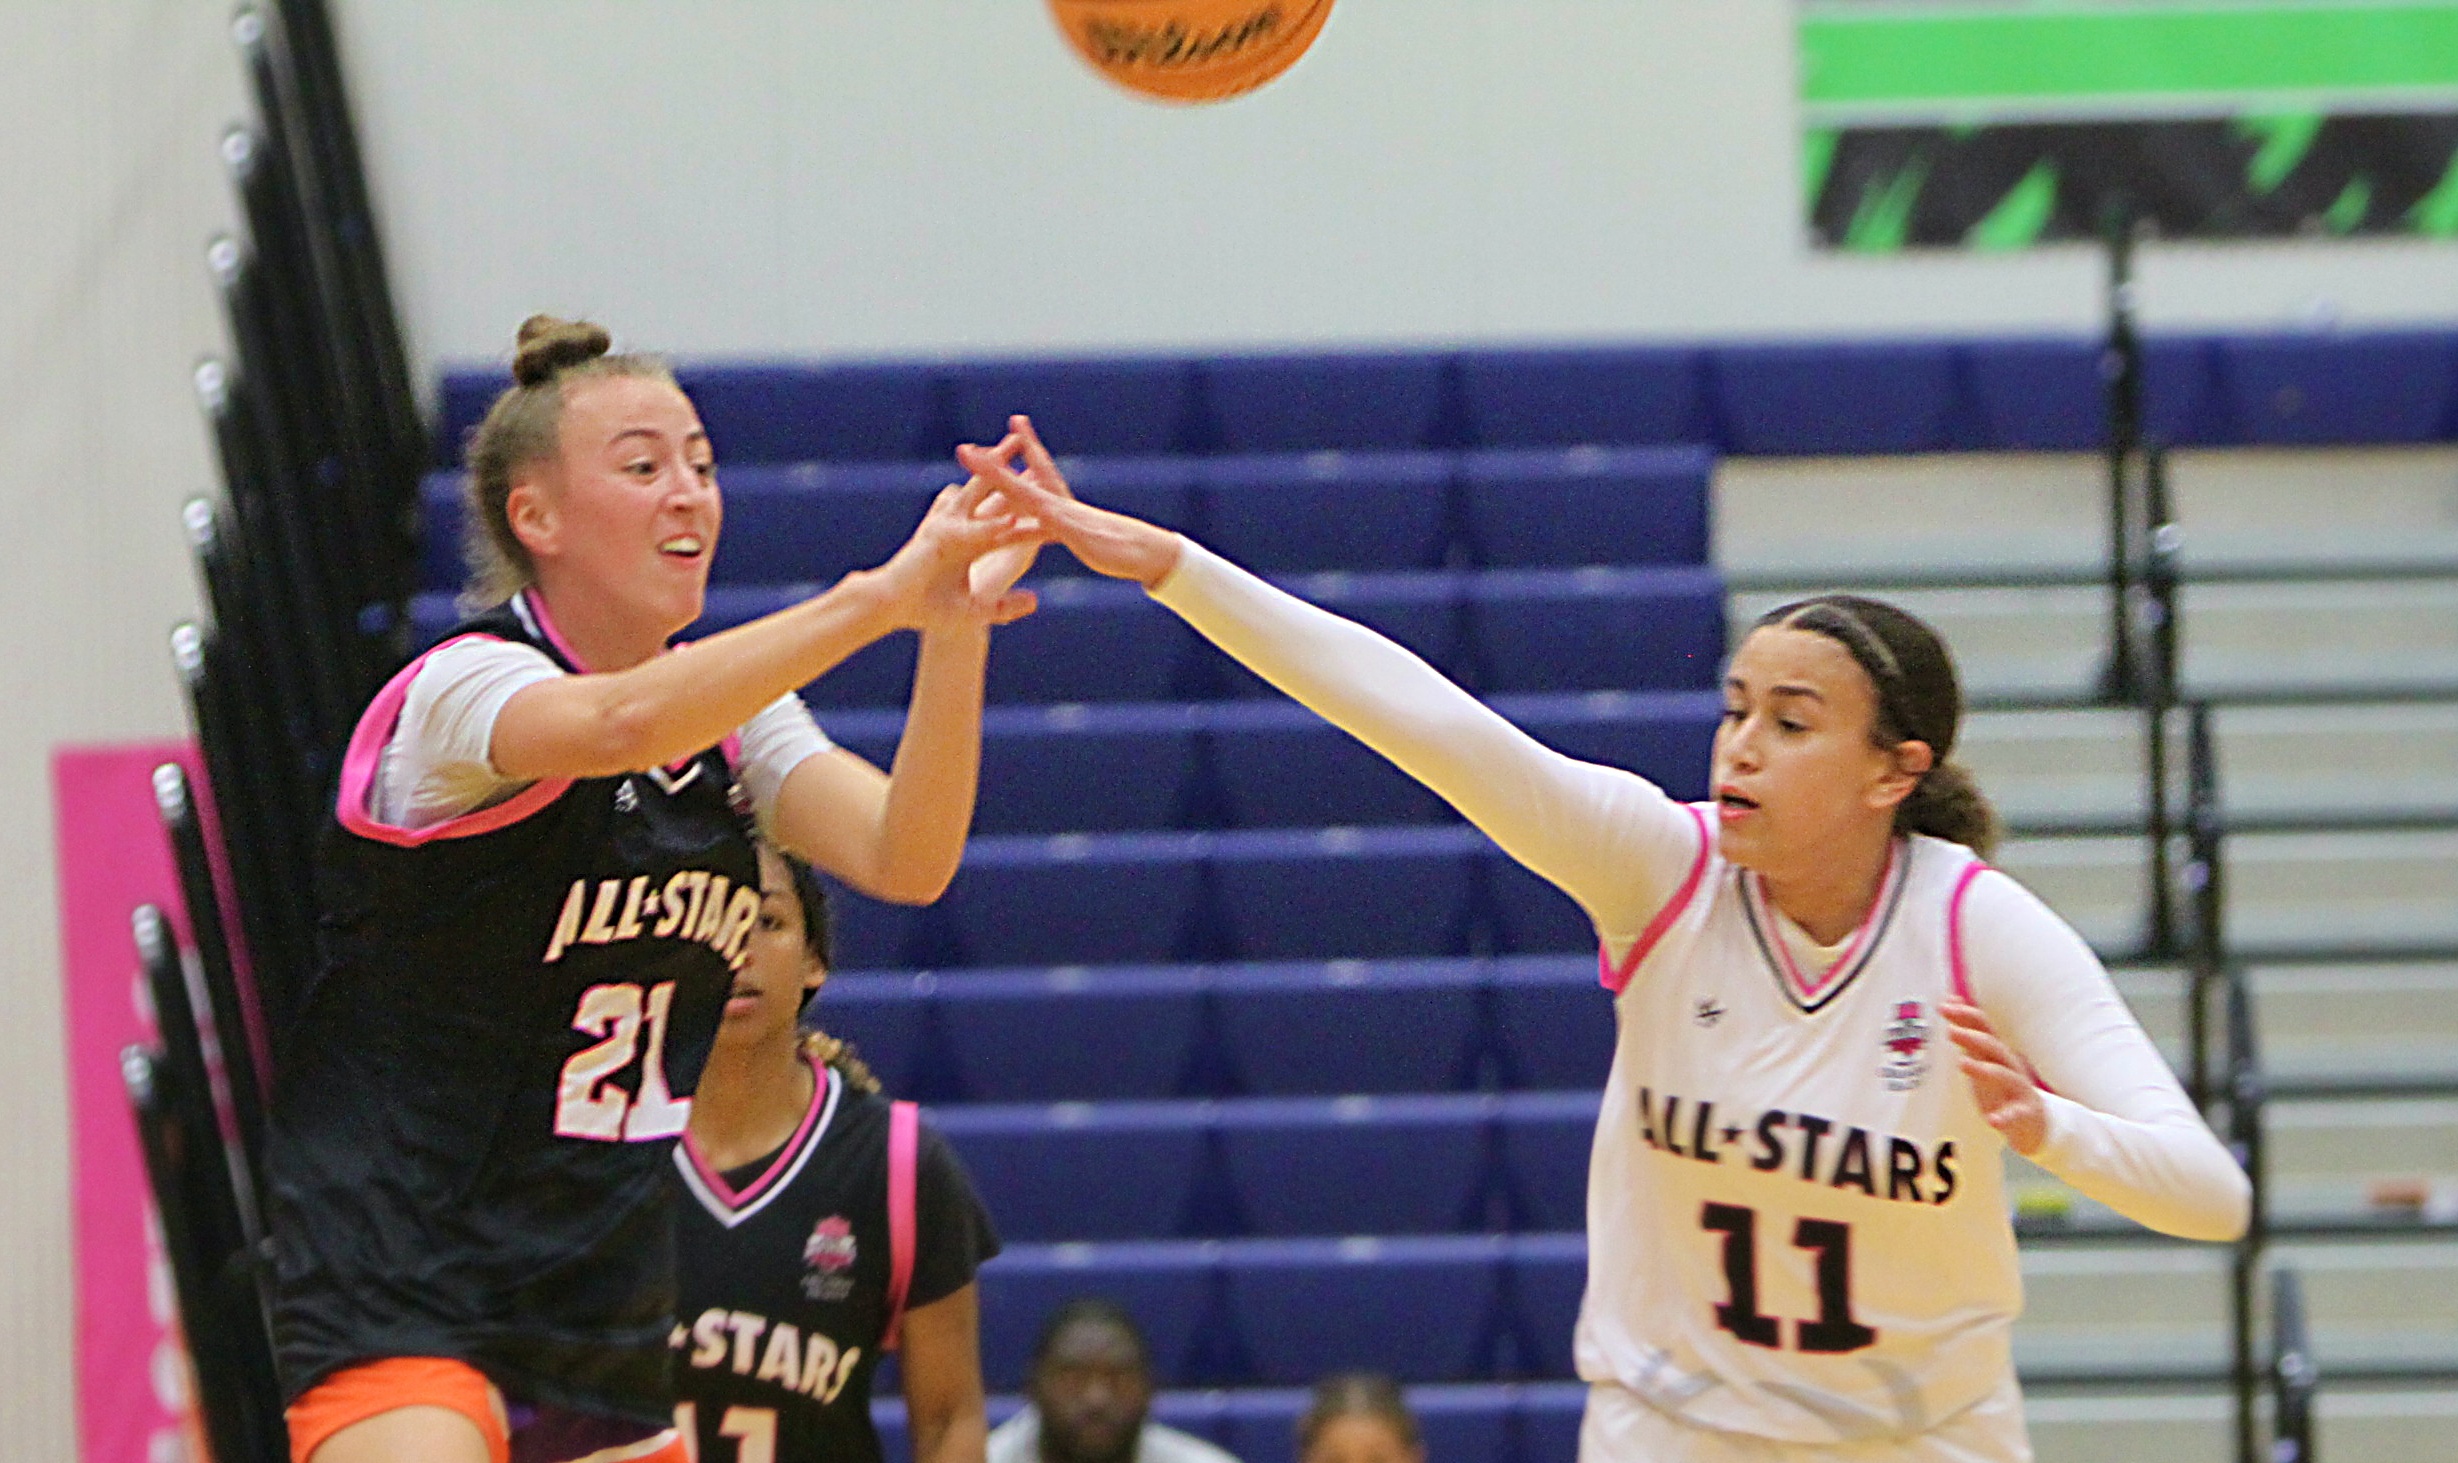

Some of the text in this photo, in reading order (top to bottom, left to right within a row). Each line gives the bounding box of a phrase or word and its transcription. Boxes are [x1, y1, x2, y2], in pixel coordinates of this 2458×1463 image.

[653, 870, 761, 971] STAR
[553, 980, 694, 1142] 21
[1700, 1201, 1877, 1354] 11
